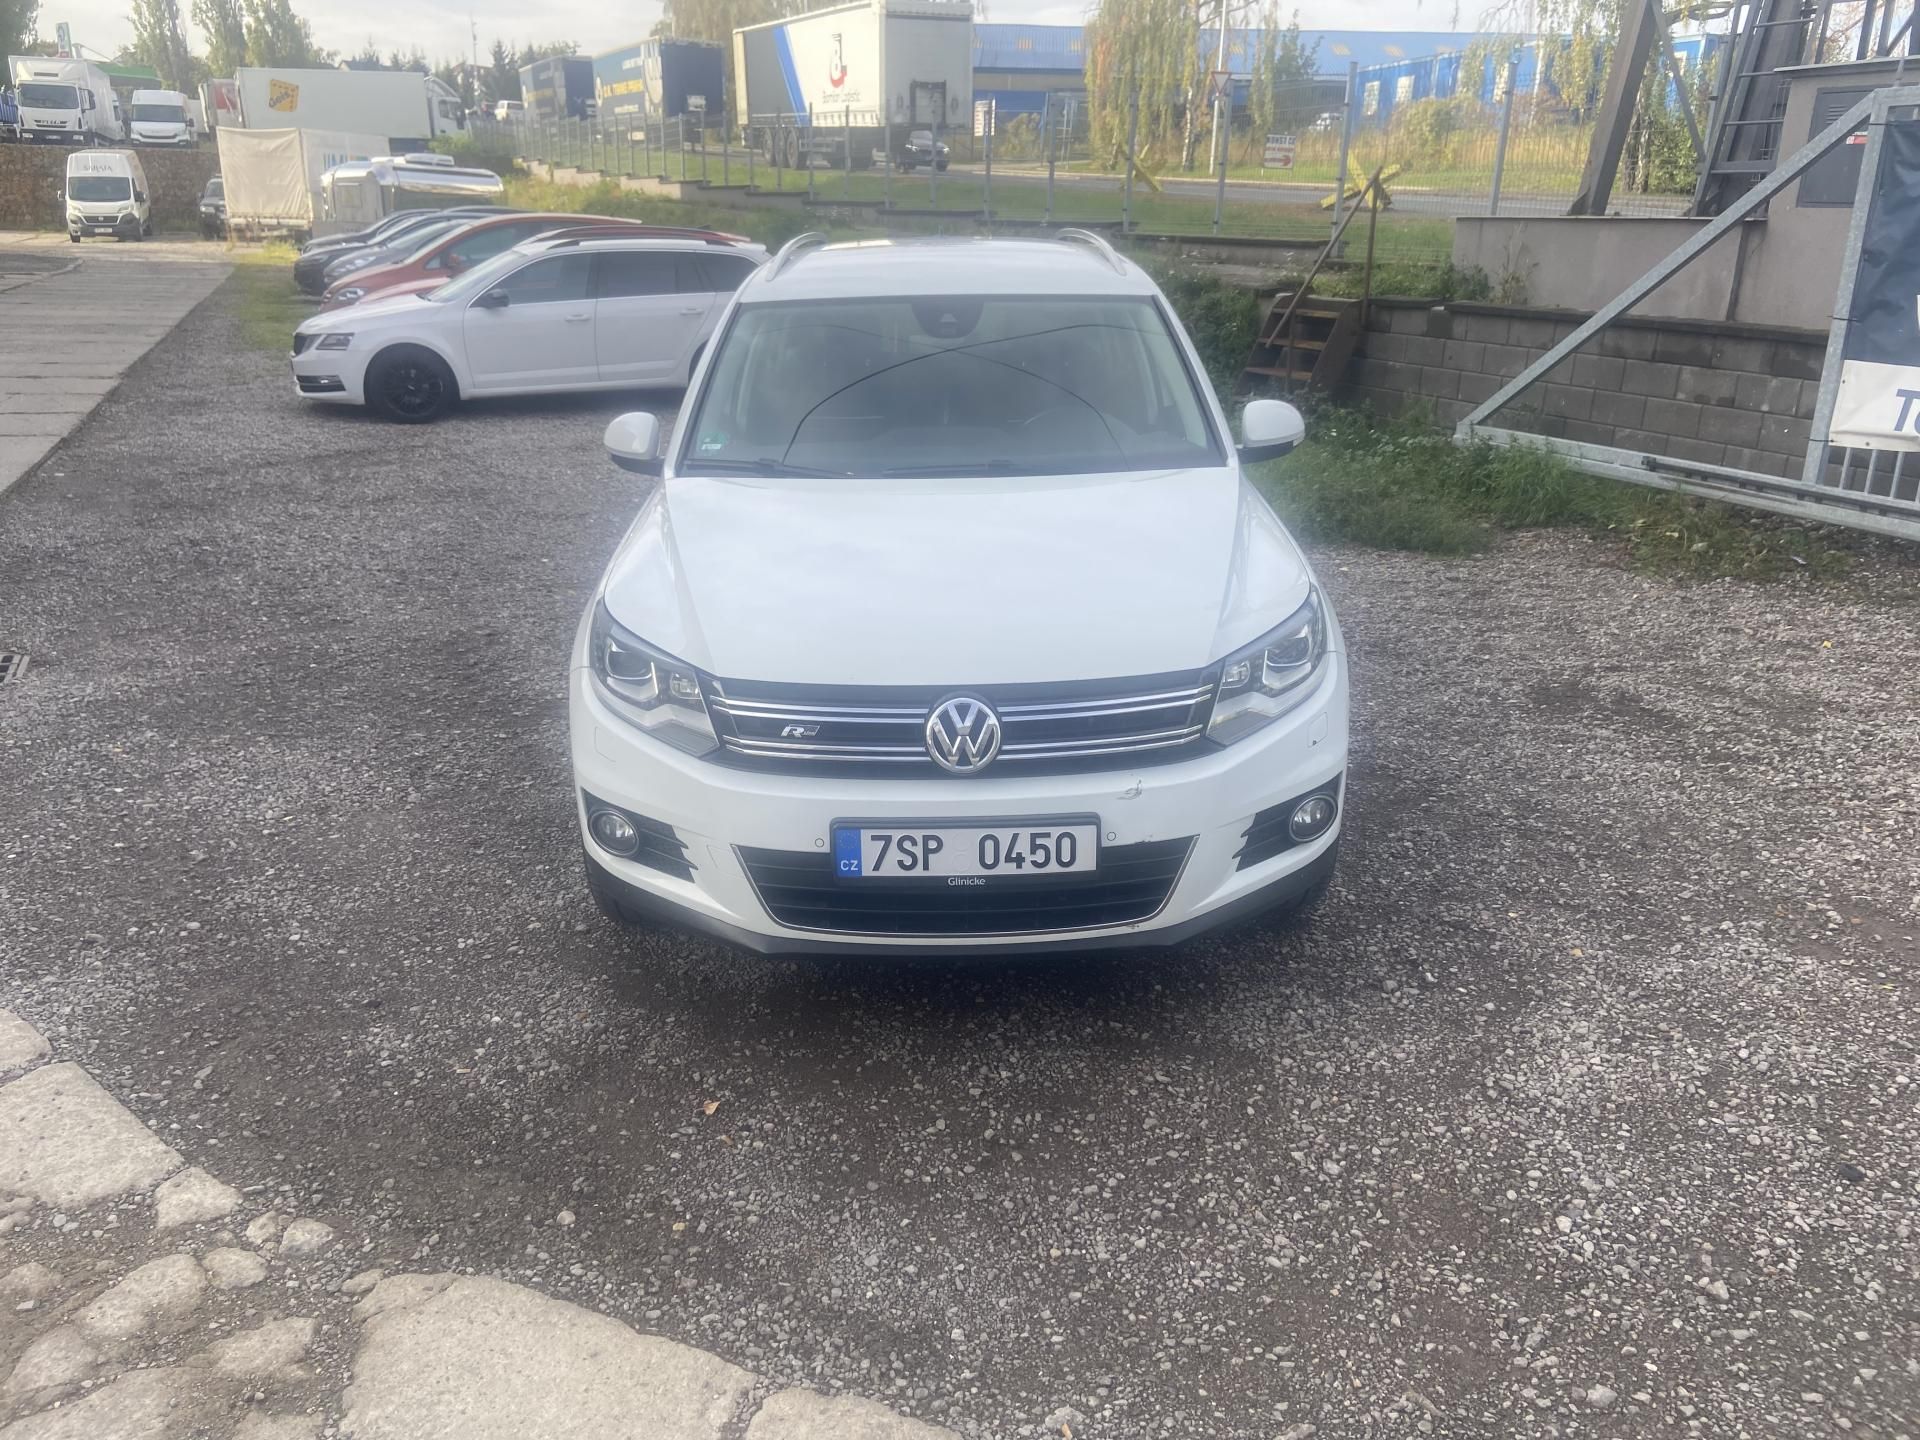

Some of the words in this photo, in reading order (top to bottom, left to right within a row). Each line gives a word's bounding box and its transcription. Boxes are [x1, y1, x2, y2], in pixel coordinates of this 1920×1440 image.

[1894, 388, 1920, 433] T
[927, 698, 1000, 773] VW
[840, 860, 858, 870] CZ
[870, 834, 944, 871] 7SP
[978, 831, 1077, 870] 0450
[948, 877, 986, 886] Glinicke
